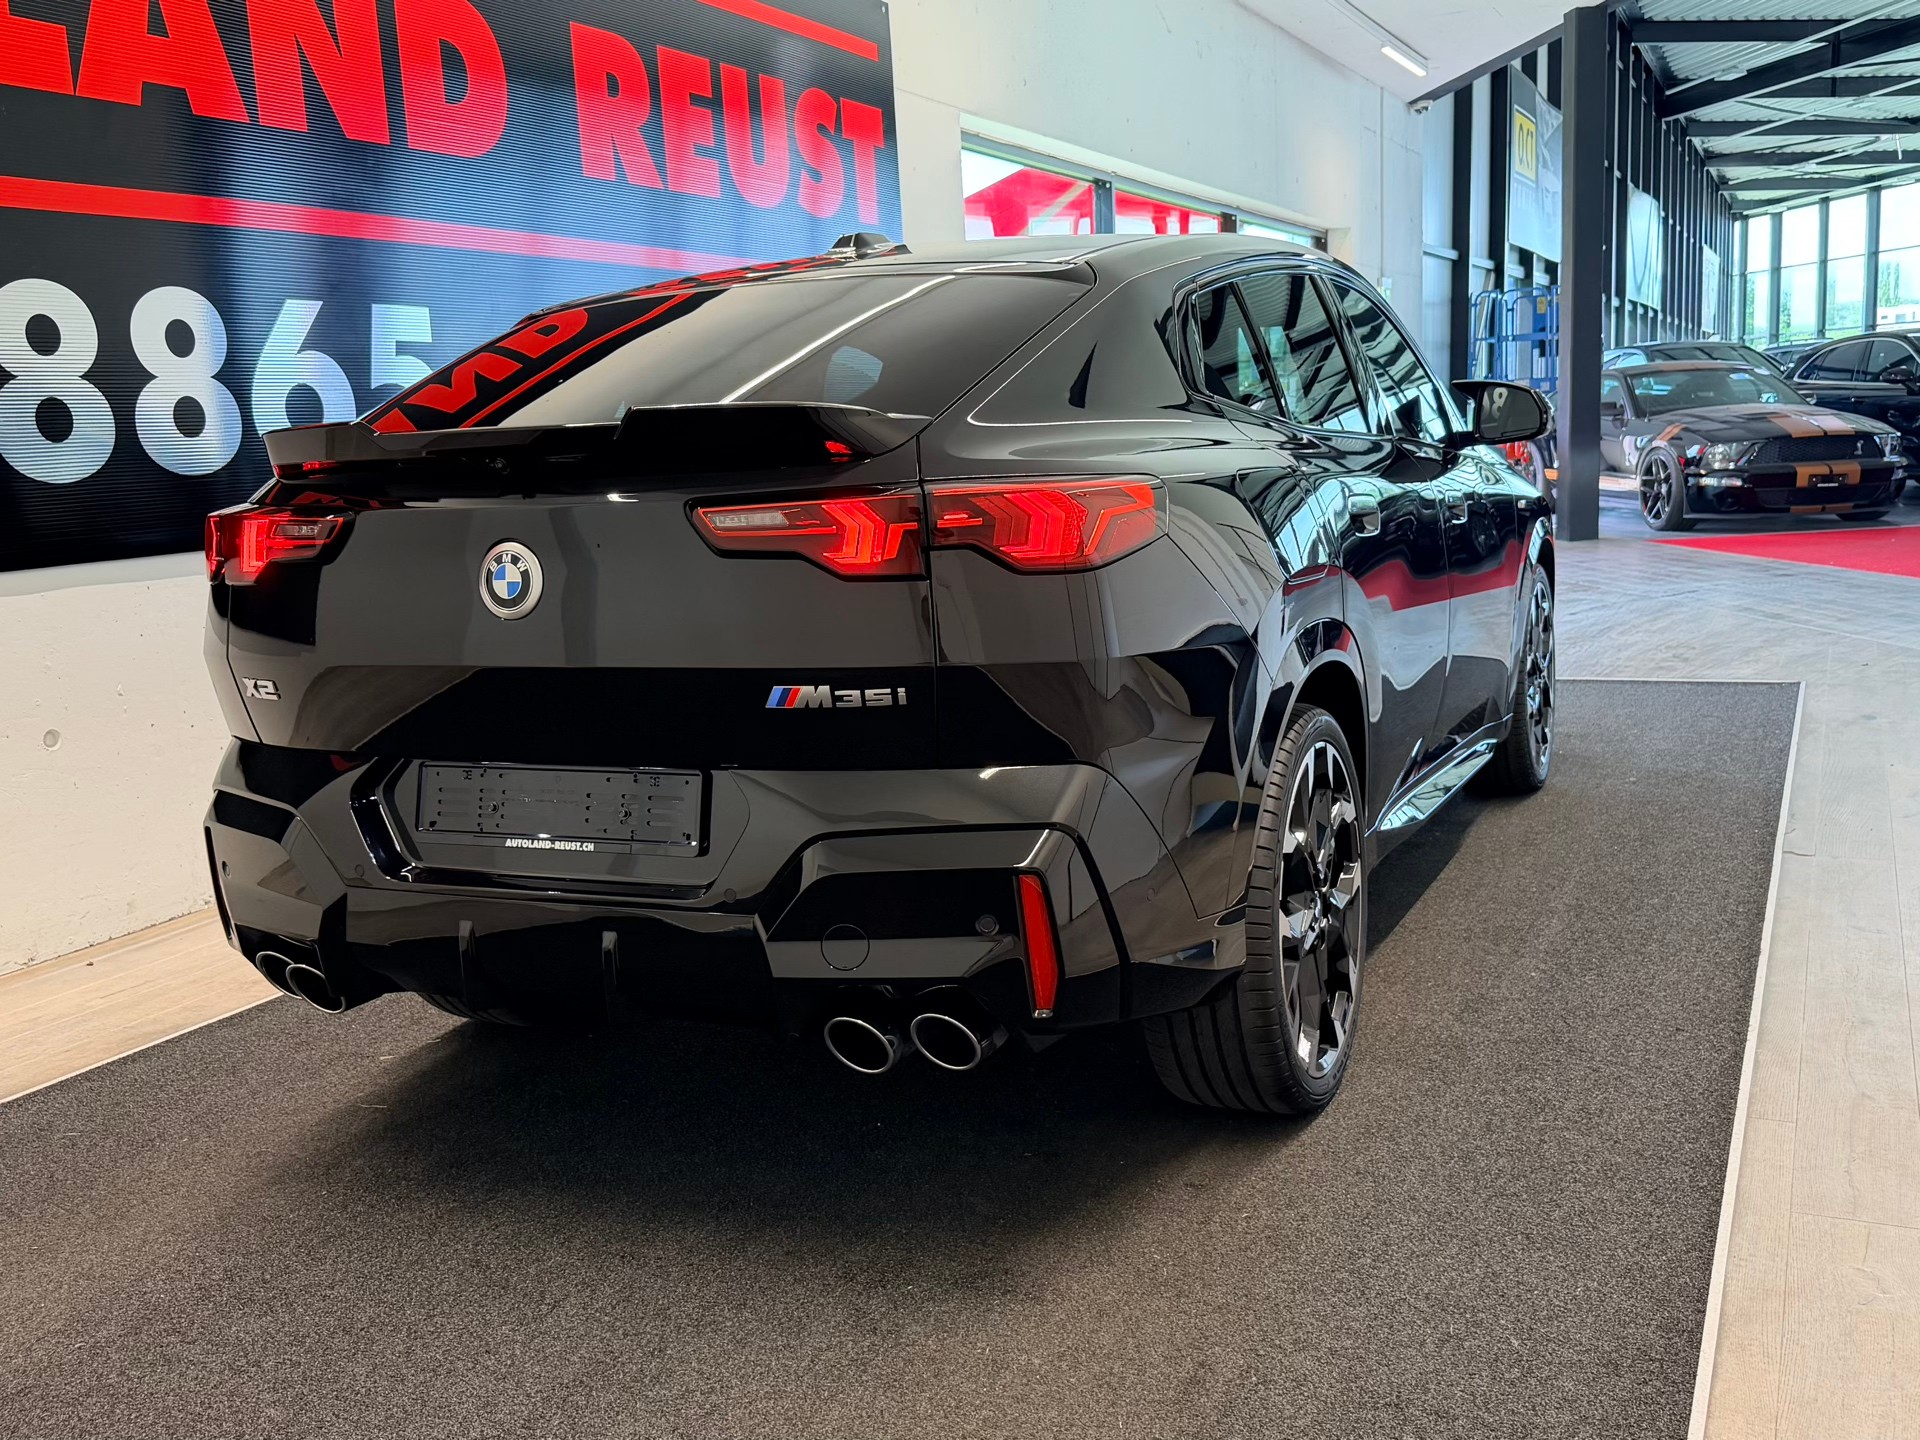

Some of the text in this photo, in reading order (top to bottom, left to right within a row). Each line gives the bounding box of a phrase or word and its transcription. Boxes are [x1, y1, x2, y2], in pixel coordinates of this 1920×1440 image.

[569, 21, 885, 225] REUST
[0, 278, 432, 484] 8865
[489, 553, 527, 573] BMW
[242, 677, 280, 700] X2
[793, 685, 907, 708] M35i
[505, 839, 594, 851] AUTOLAND-REUST.CH
